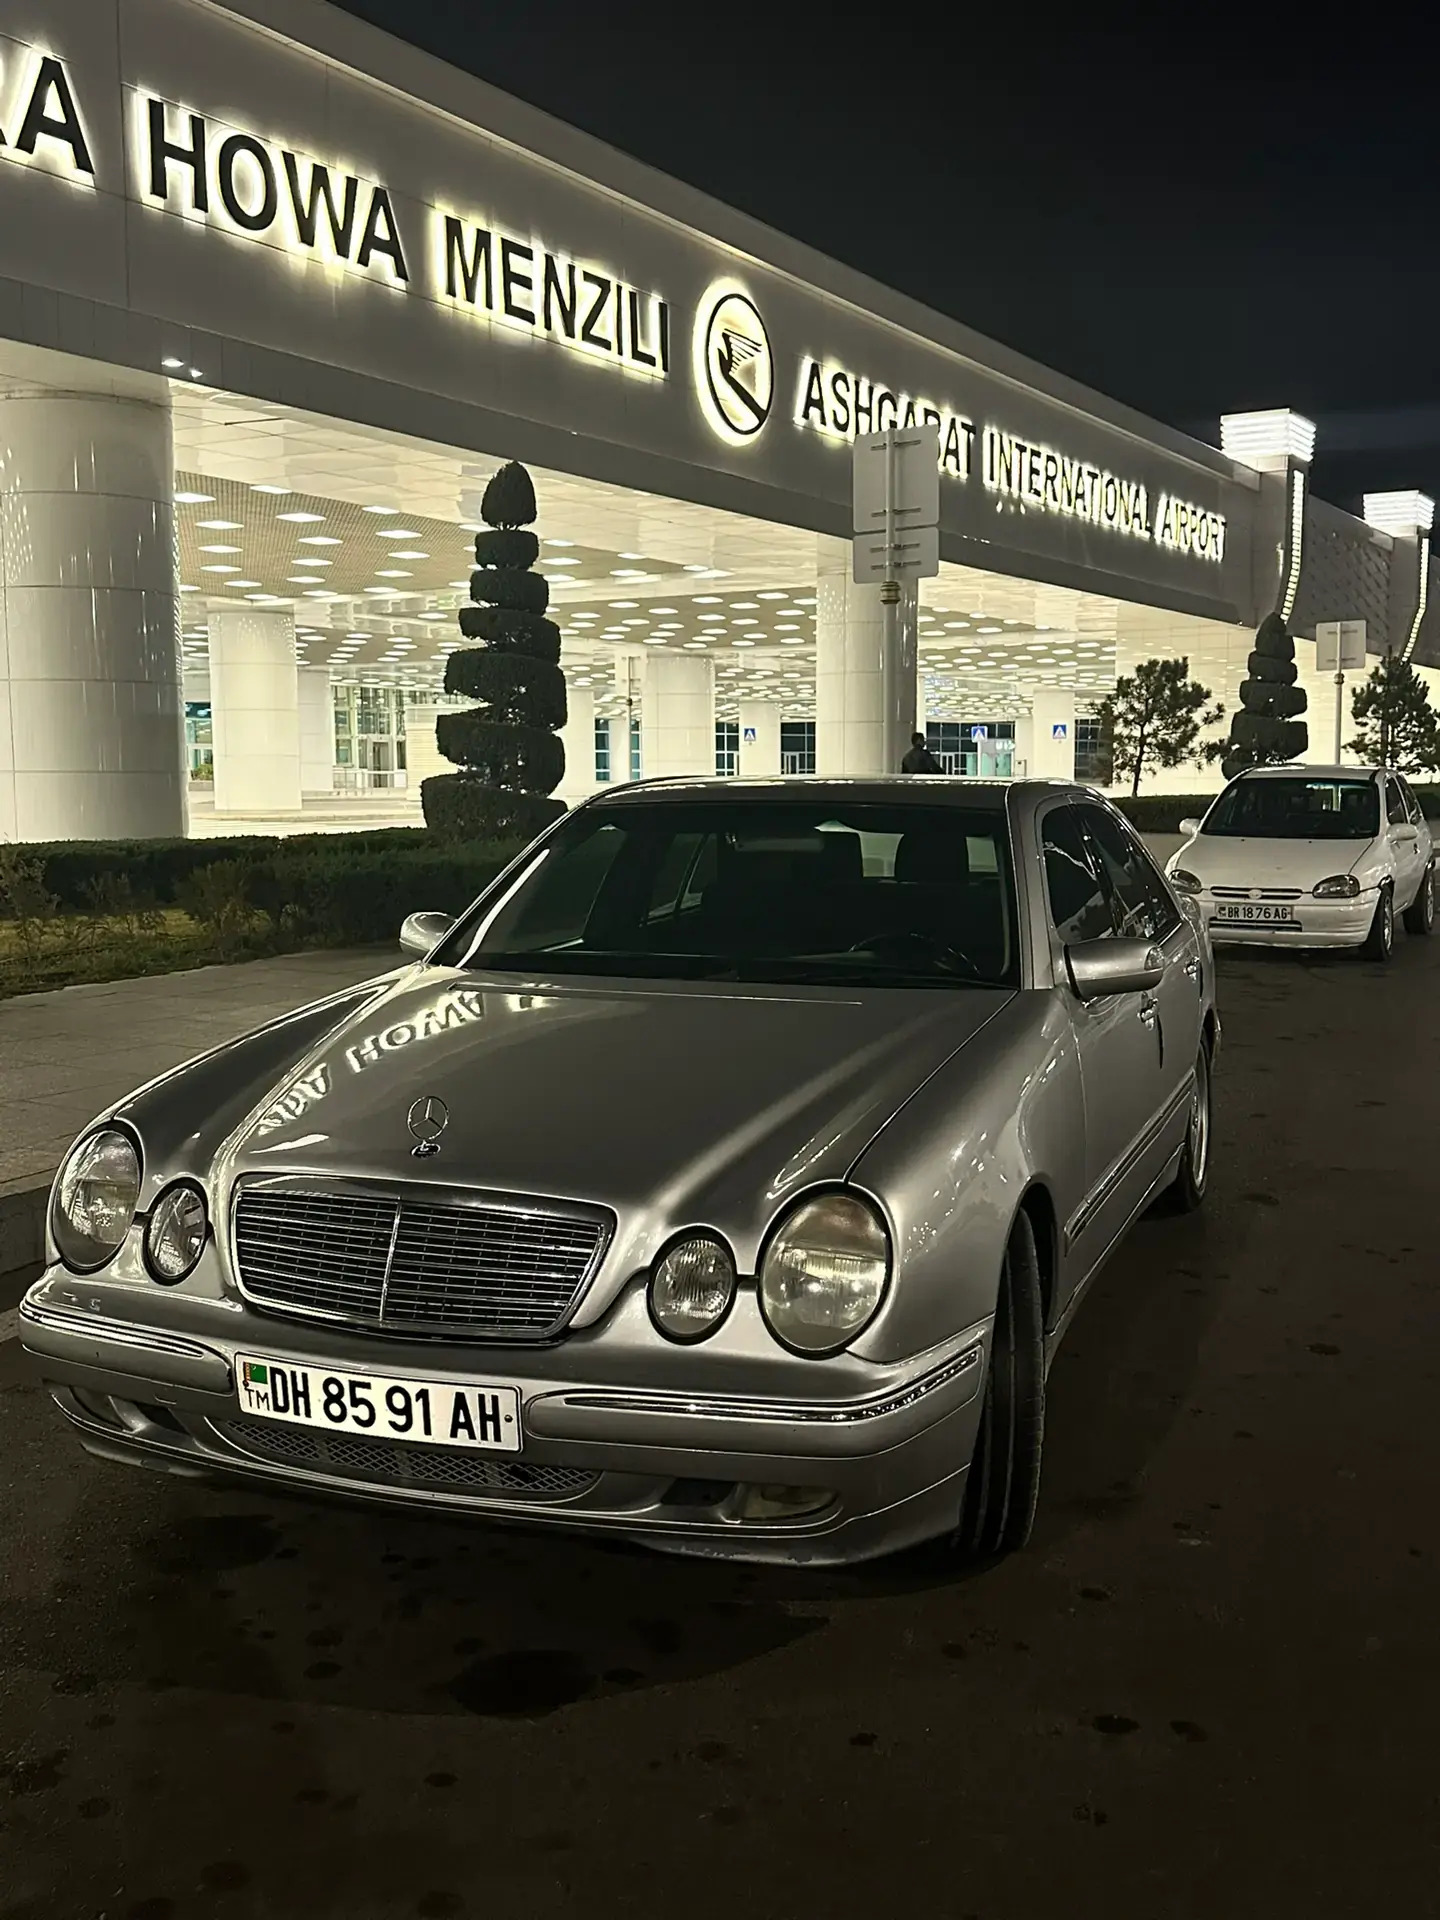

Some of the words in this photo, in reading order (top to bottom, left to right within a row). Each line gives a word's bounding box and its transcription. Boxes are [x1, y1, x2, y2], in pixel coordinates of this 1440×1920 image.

[0, 56, 95, 174] A
[147, 98, 409, 282] HOWA
[444, 215, 669, 373] MENZILI
[989, 431, 1151, 537] INTERNATIONAL
[1161, 498, 1227, 560] AIRPORT
[1228, 906, 1240, 918] BR
[1242, 906, 1254, 918] 18
[1255, 907, 1271, 919] 76
[1273, 907, 1287, 919] AG
[245, 1387, 270, 1411] TM
[269, 1366, 311, 1418] DH
[322, 1377, 376, 1428] 85
[385, 1385, 432, 1436] 91
[450, 1391, 502, 1442] AH
